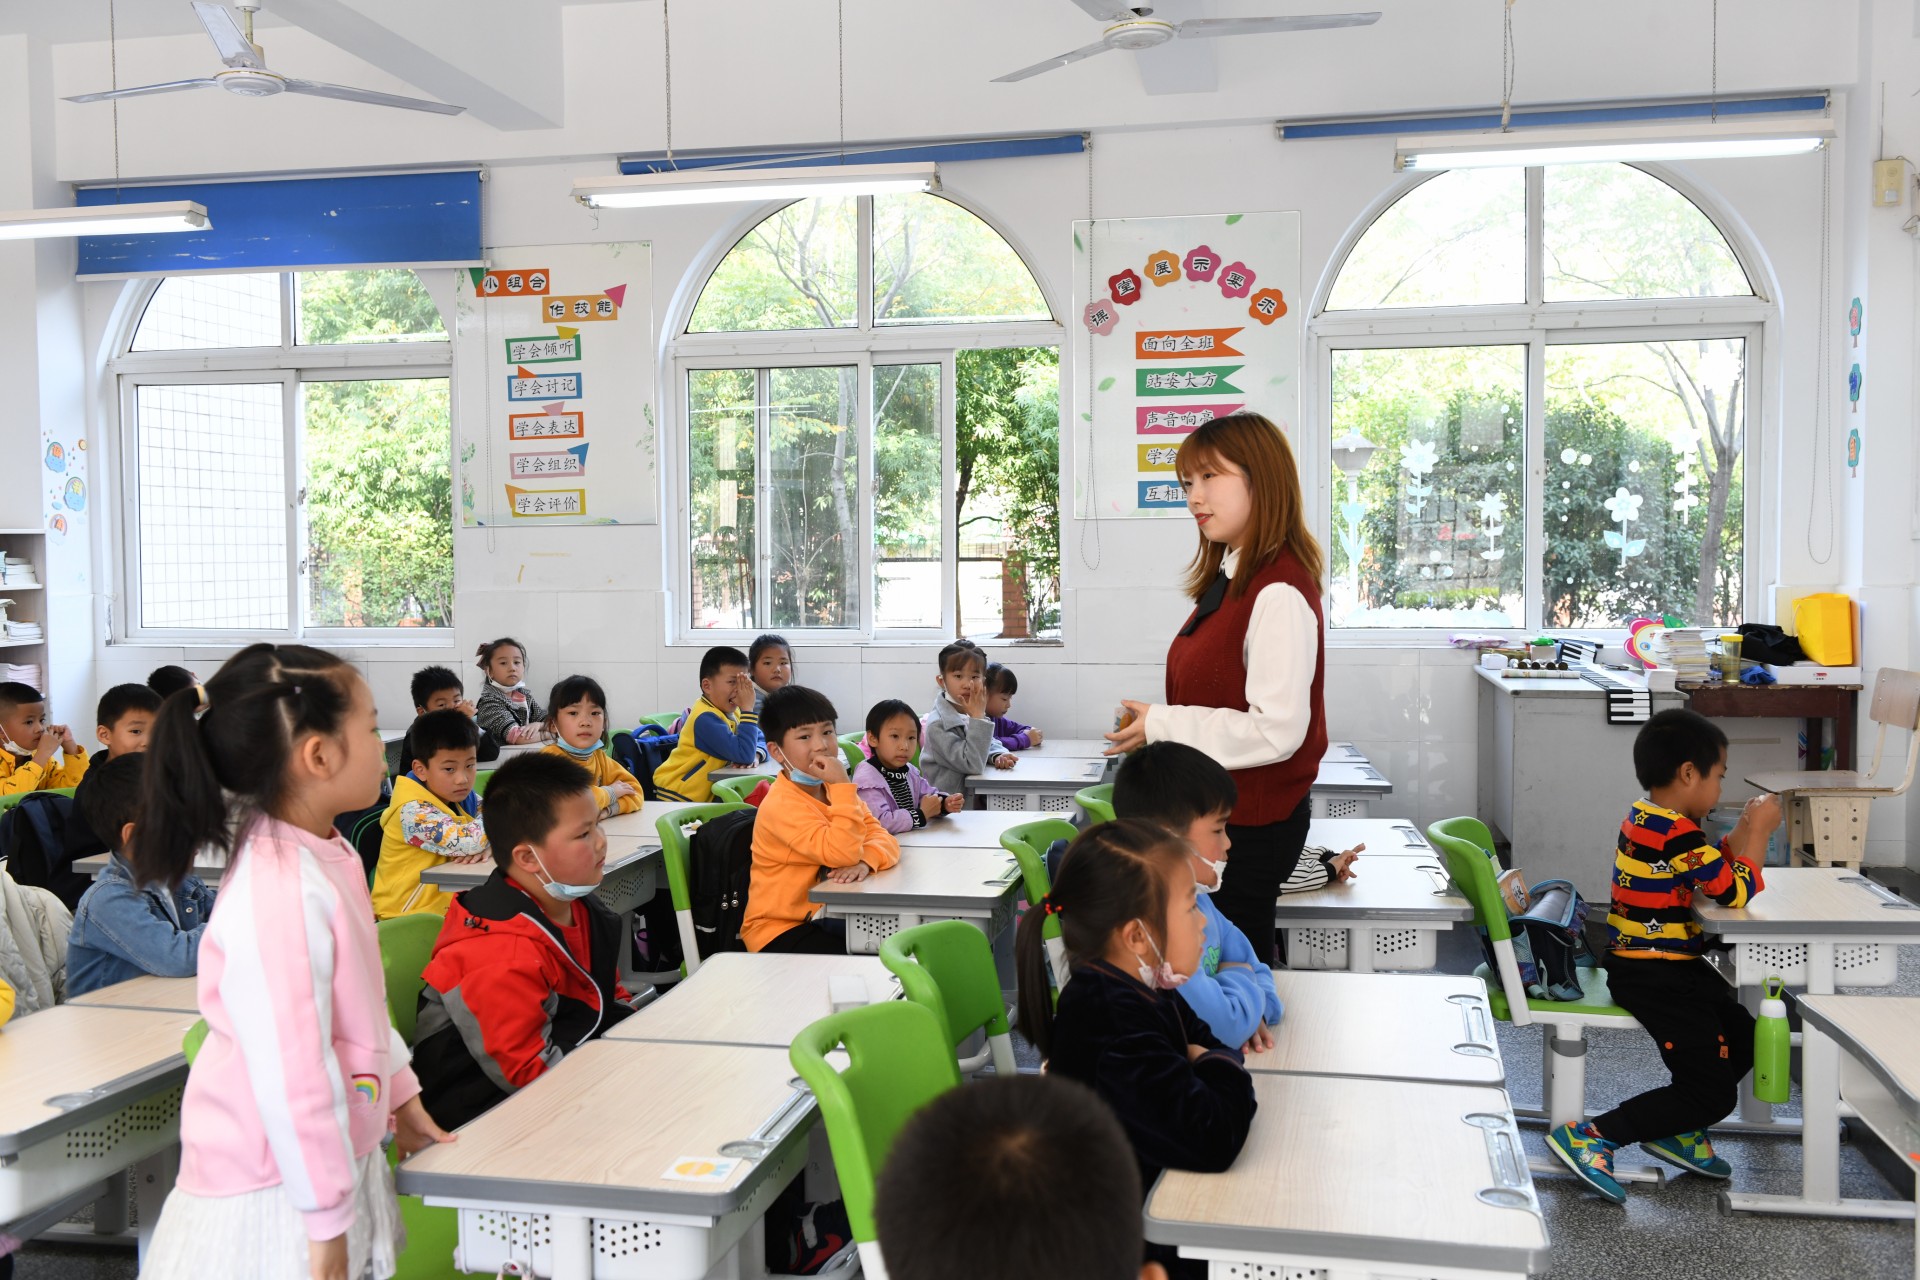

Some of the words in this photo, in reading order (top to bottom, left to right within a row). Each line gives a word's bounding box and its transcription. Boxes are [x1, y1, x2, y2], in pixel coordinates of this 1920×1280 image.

[484, 275, 546, 291] 小组合
[549, 299, 613, 317] 作技能
[512, 340, 574, 361] 学会倾听
[1143, 334, 1214, 352] 面向全班
[1146, 372, 1217, 388] 站姿大方
[516, 419, 577, 437] 学会表达
[516, 456, 578, 473] 学会组织
[517, 495, 578, 513] 学会评价
